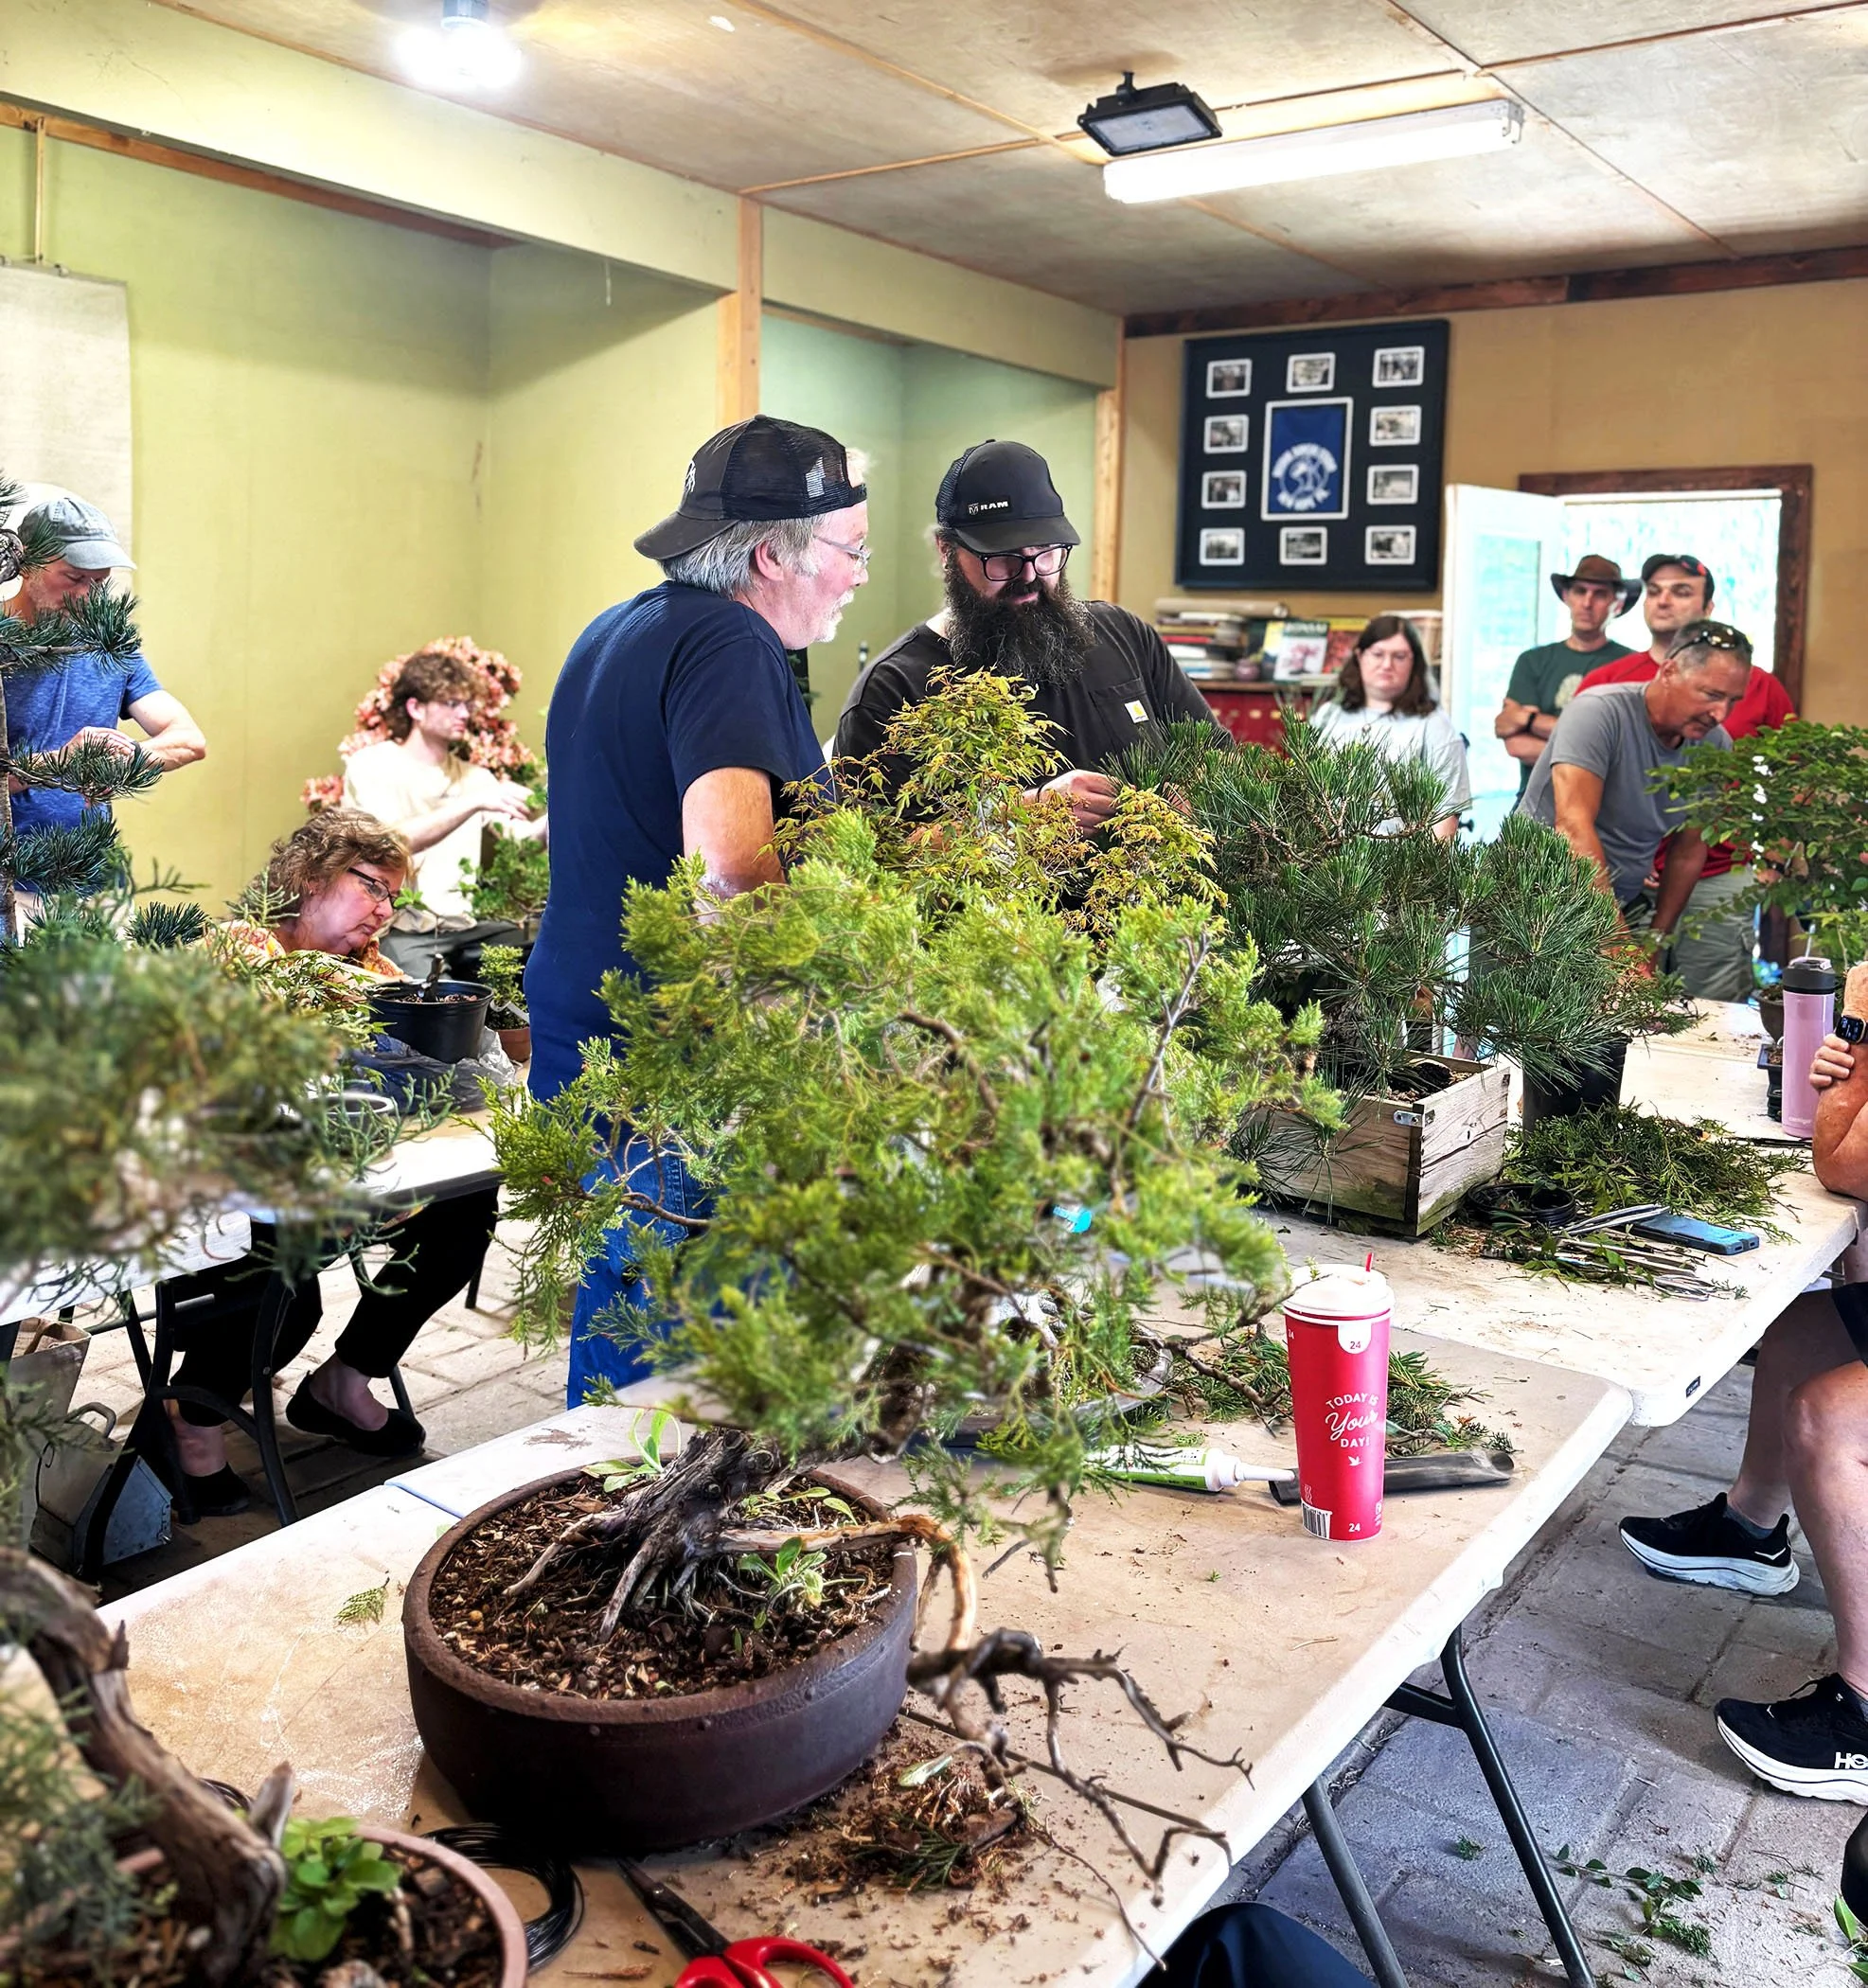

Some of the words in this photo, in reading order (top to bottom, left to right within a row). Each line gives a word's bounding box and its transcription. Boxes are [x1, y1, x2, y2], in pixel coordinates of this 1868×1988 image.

[980, 501, 1009, 511] RAM
[1349, 1340, 1361, 1350] 24
[1325, 1393, 1368, 1410] TODAY
[1325, 1409, 1379, 1441] Your
[1340, 1435, 1370, 1448] DAY!
[1348, 1522, 1361, 1533] 24
[1834, 1751, 1868, 1769] HO
